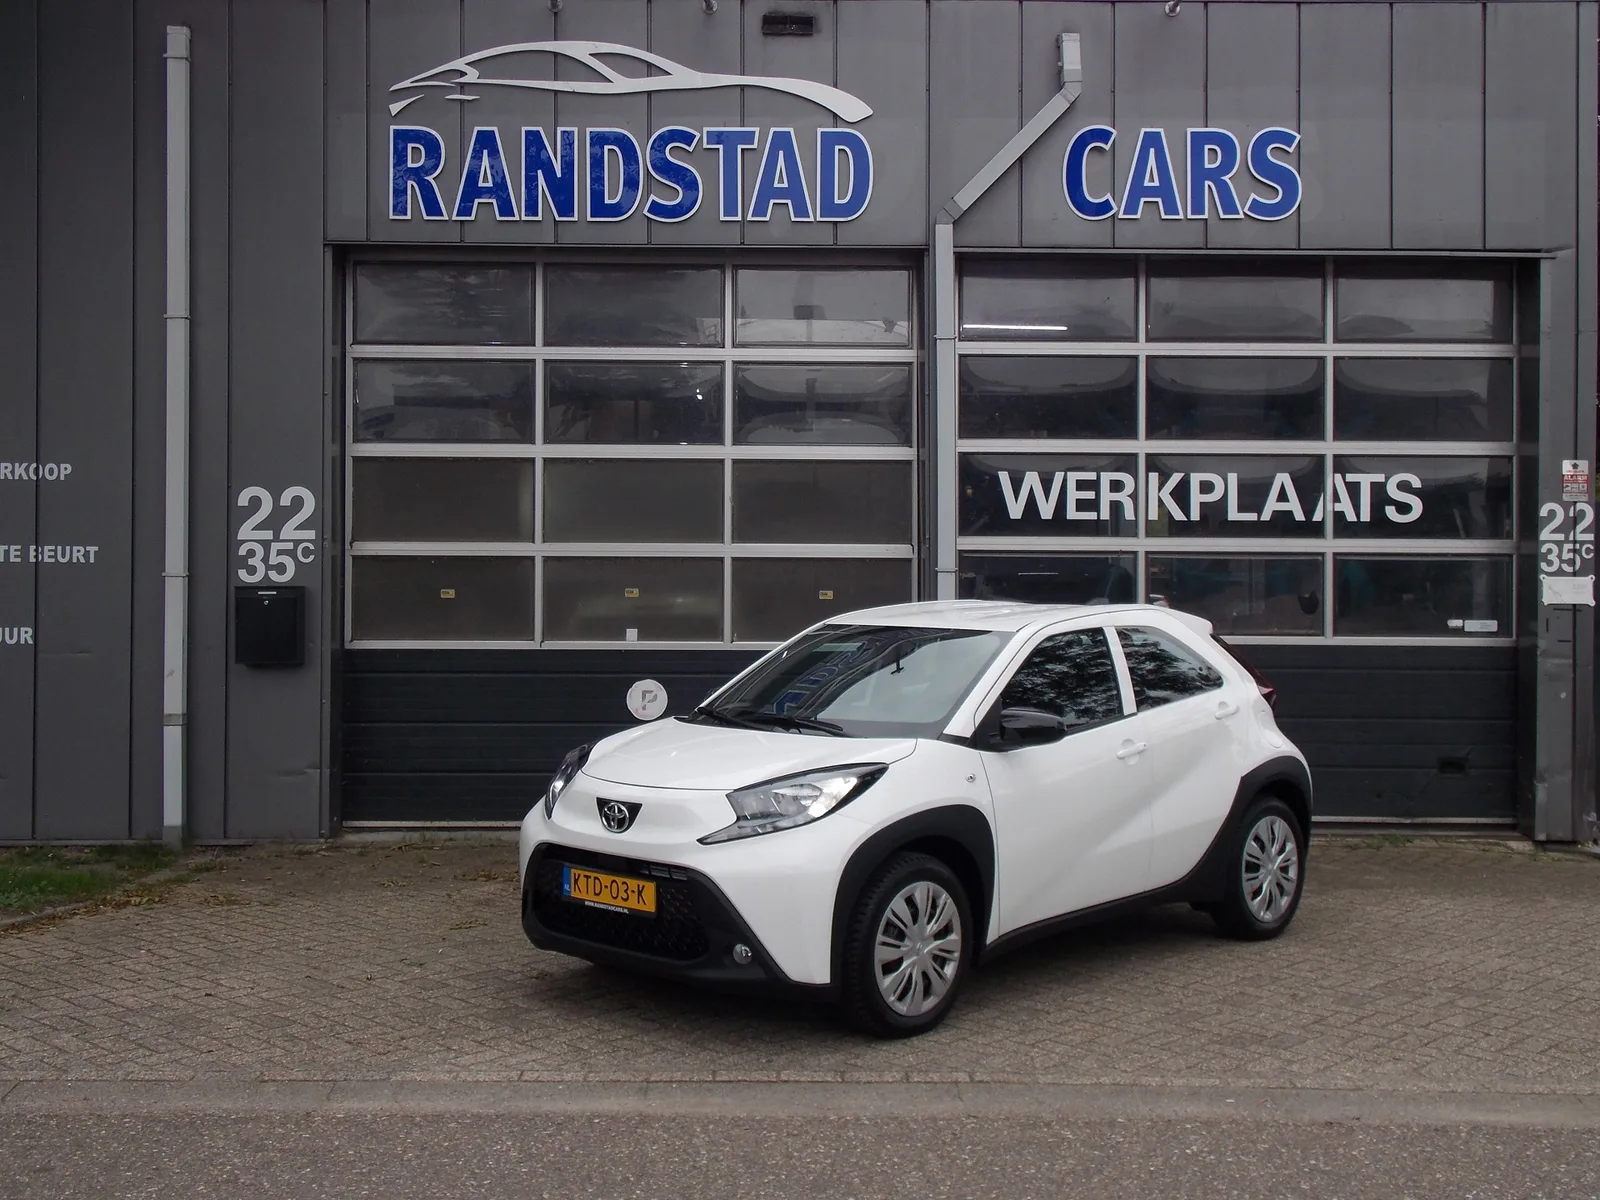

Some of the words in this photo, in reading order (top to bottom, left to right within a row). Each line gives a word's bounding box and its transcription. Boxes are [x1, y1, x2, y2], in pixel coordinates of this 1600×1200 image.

[389, 125, 874, 223] RANDSTAD
[1062, 124, 1303, 221] CARS
[0, 462, 72, 481] RKOOP
[237, 486, 316, 540] 22
[998, 471, 1424, 523] WERKPLAATS
[1539, 502, 1594, 541] 22
[29, 545, 99, 563] BEURT
[0, 627, 34, 645] UR
[573, 872, 646, 906] KTD-03-K
